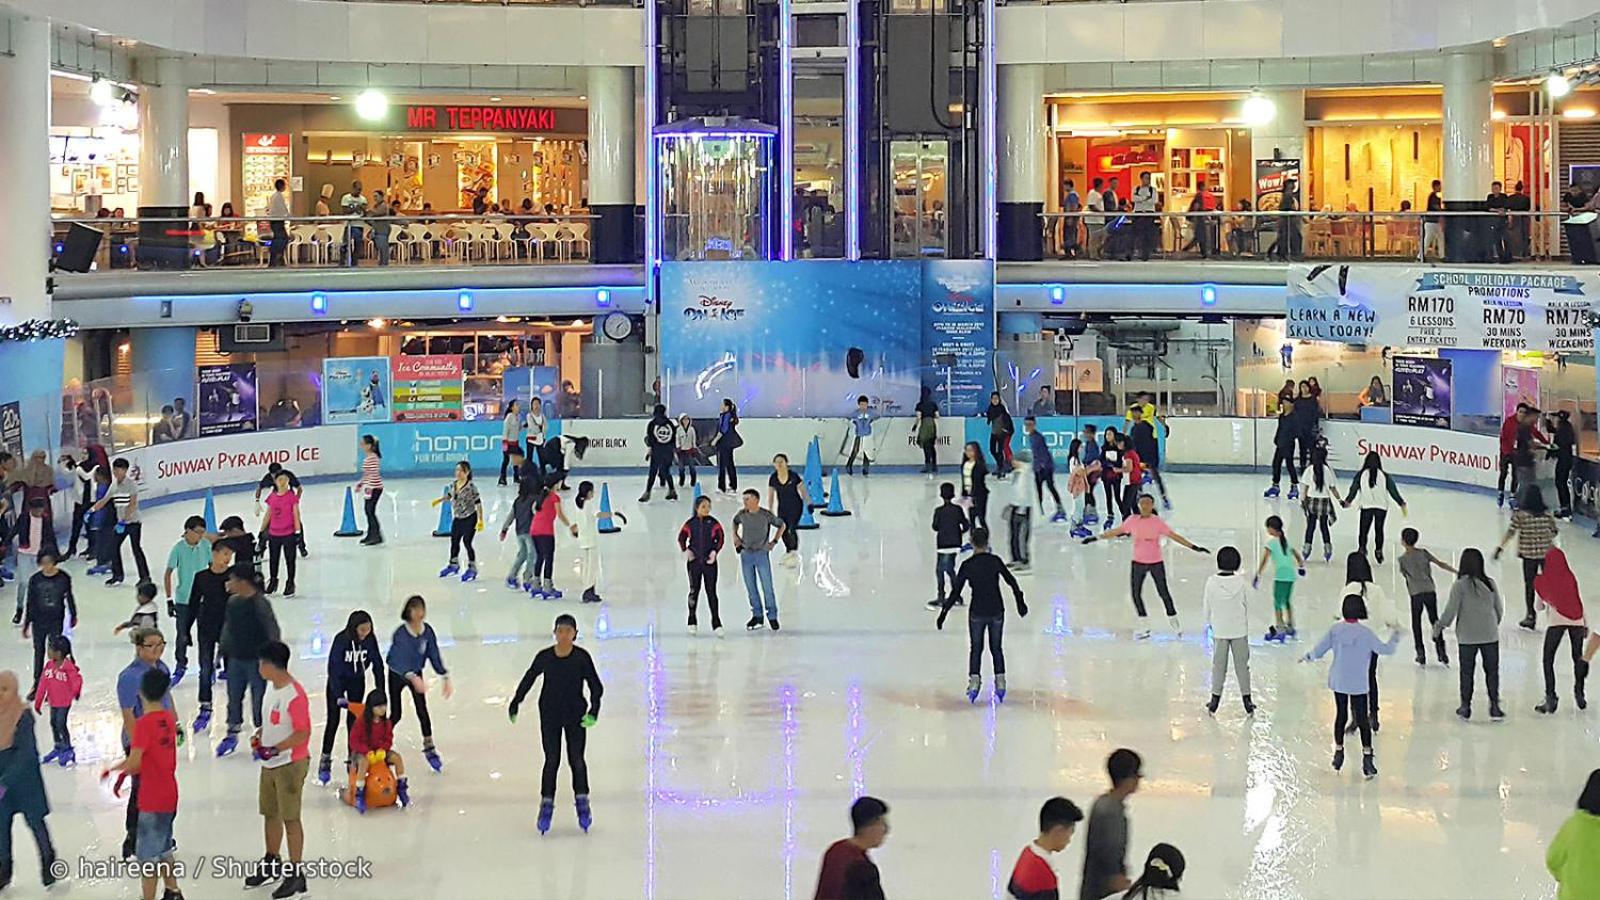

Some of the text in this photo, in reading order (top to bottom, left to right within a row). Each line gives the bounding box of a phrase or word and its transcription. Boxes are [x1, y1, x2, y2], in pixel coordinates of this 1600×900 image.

[407, 107, 555, 129] MR TEPPANYAKI
[1433, 273, 1567, 288] SCHOOL HOLIDAY PACKAGE
[1468, 286, 1530, 298] PROMOTIONS
[1290, 308, 1376, 323] LEARN A NEW
[1410, 316, 1454, 327] 6 LESSONS
[1289, 325, 1374, 338] SKILL TODAY!
[1486, 327, 1522, 337] 30 MINS
[1556, 327, 1592, 338] 30 MINS
[1482, 338, 1527, 349] WEEKDAYS
[1549, 339, 1595, 349] WEEKENDS
[398, 362, 411, 373] Ice
[412, 361, 458, 375] Community
[415, 430, 503, 452] honor
[605, 438, 627, 448] BLACK
[158, 445, 320, 479] SUNWAY PYRAMID ICE
[1430, 445, 1491, 470] PYRAMID
[345, 650, 368, 662] NYC
